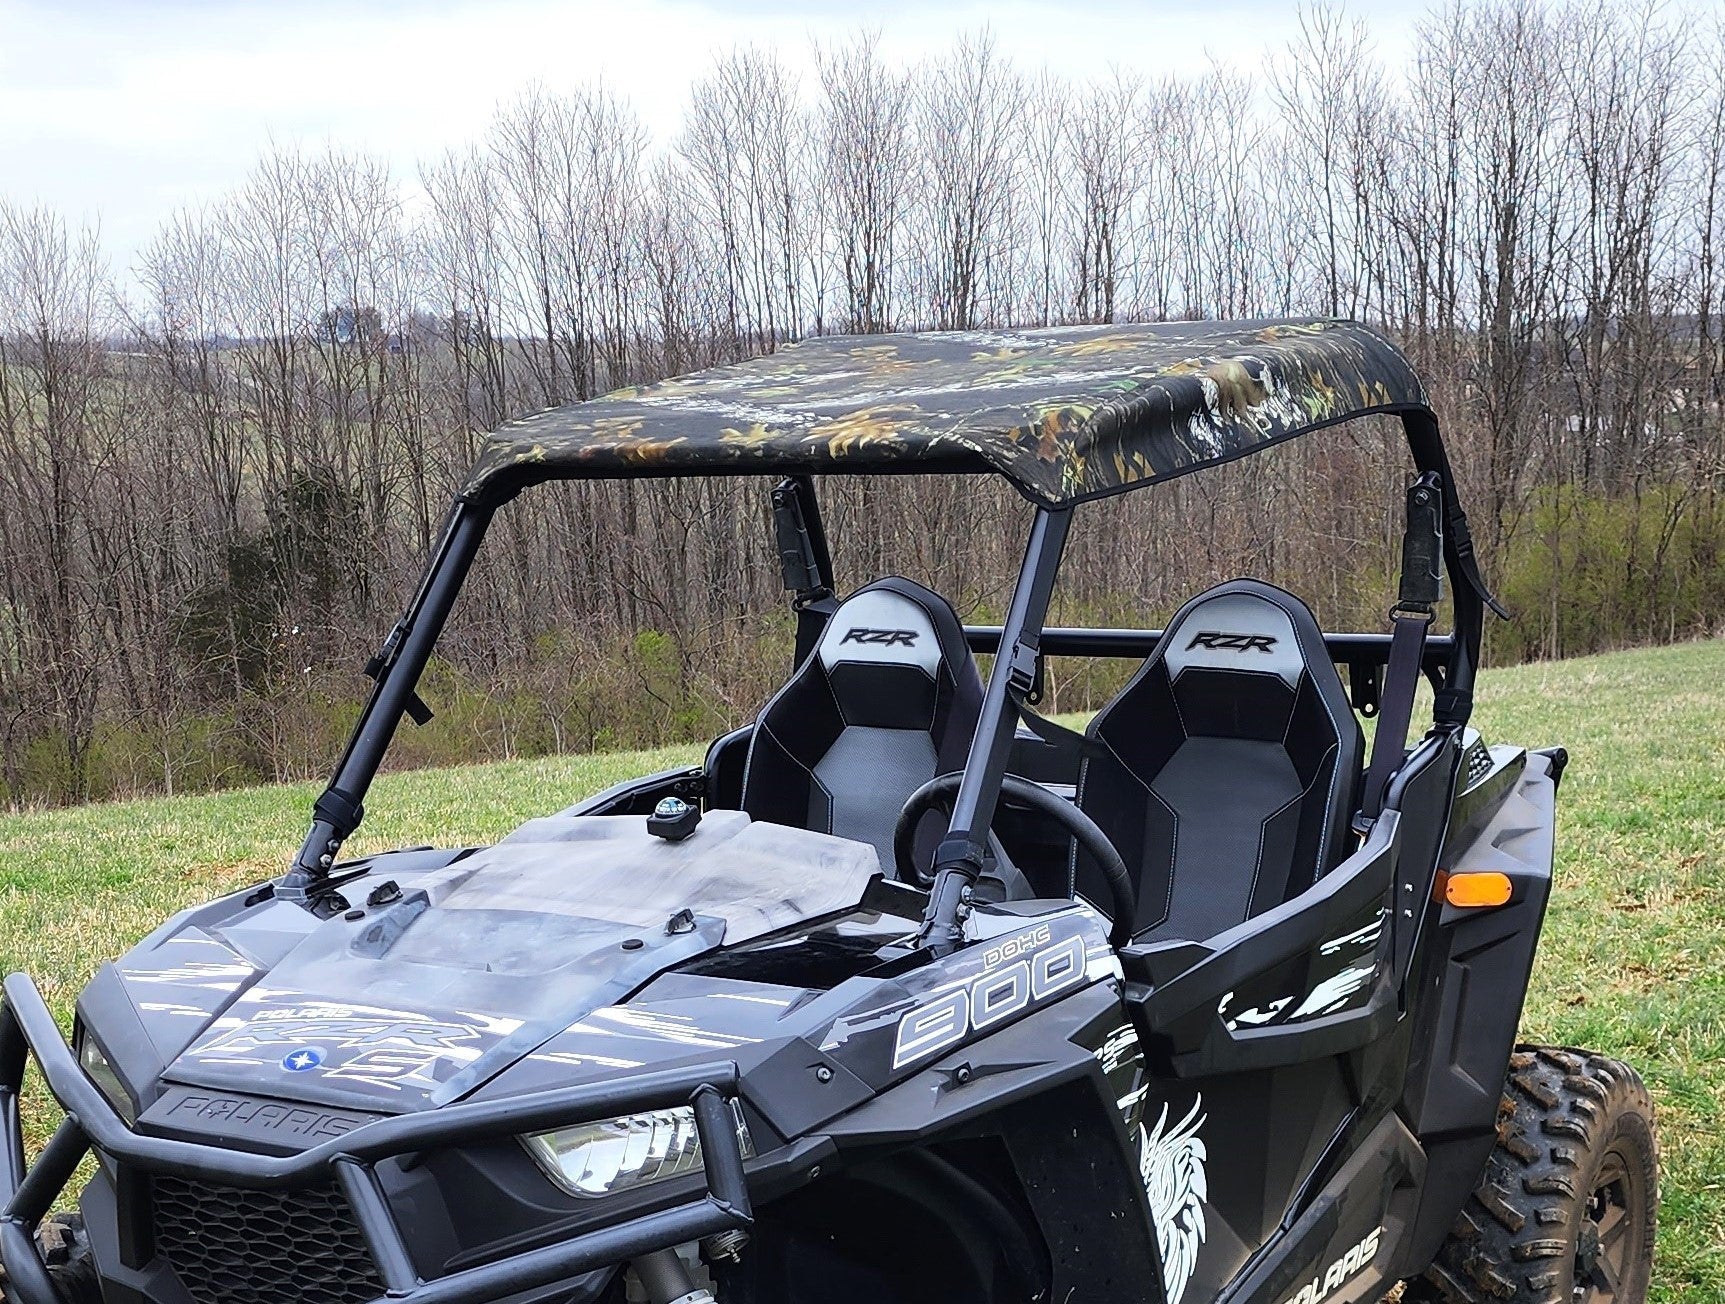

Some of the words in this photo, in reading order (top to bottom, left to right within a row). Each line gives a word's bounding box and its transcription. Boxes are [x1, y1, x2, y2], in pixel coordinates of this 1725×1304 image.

[838, 628, 919, 648] RZR
[1186, 632, 1278, 653] RZR
[982, 924, 1051, 970] DOHC
[252, 1007, 353, 1020] POLARIS
[893, 934, 1087, 1070] 900
[166, 1096, 359, 1136] POLARIS
